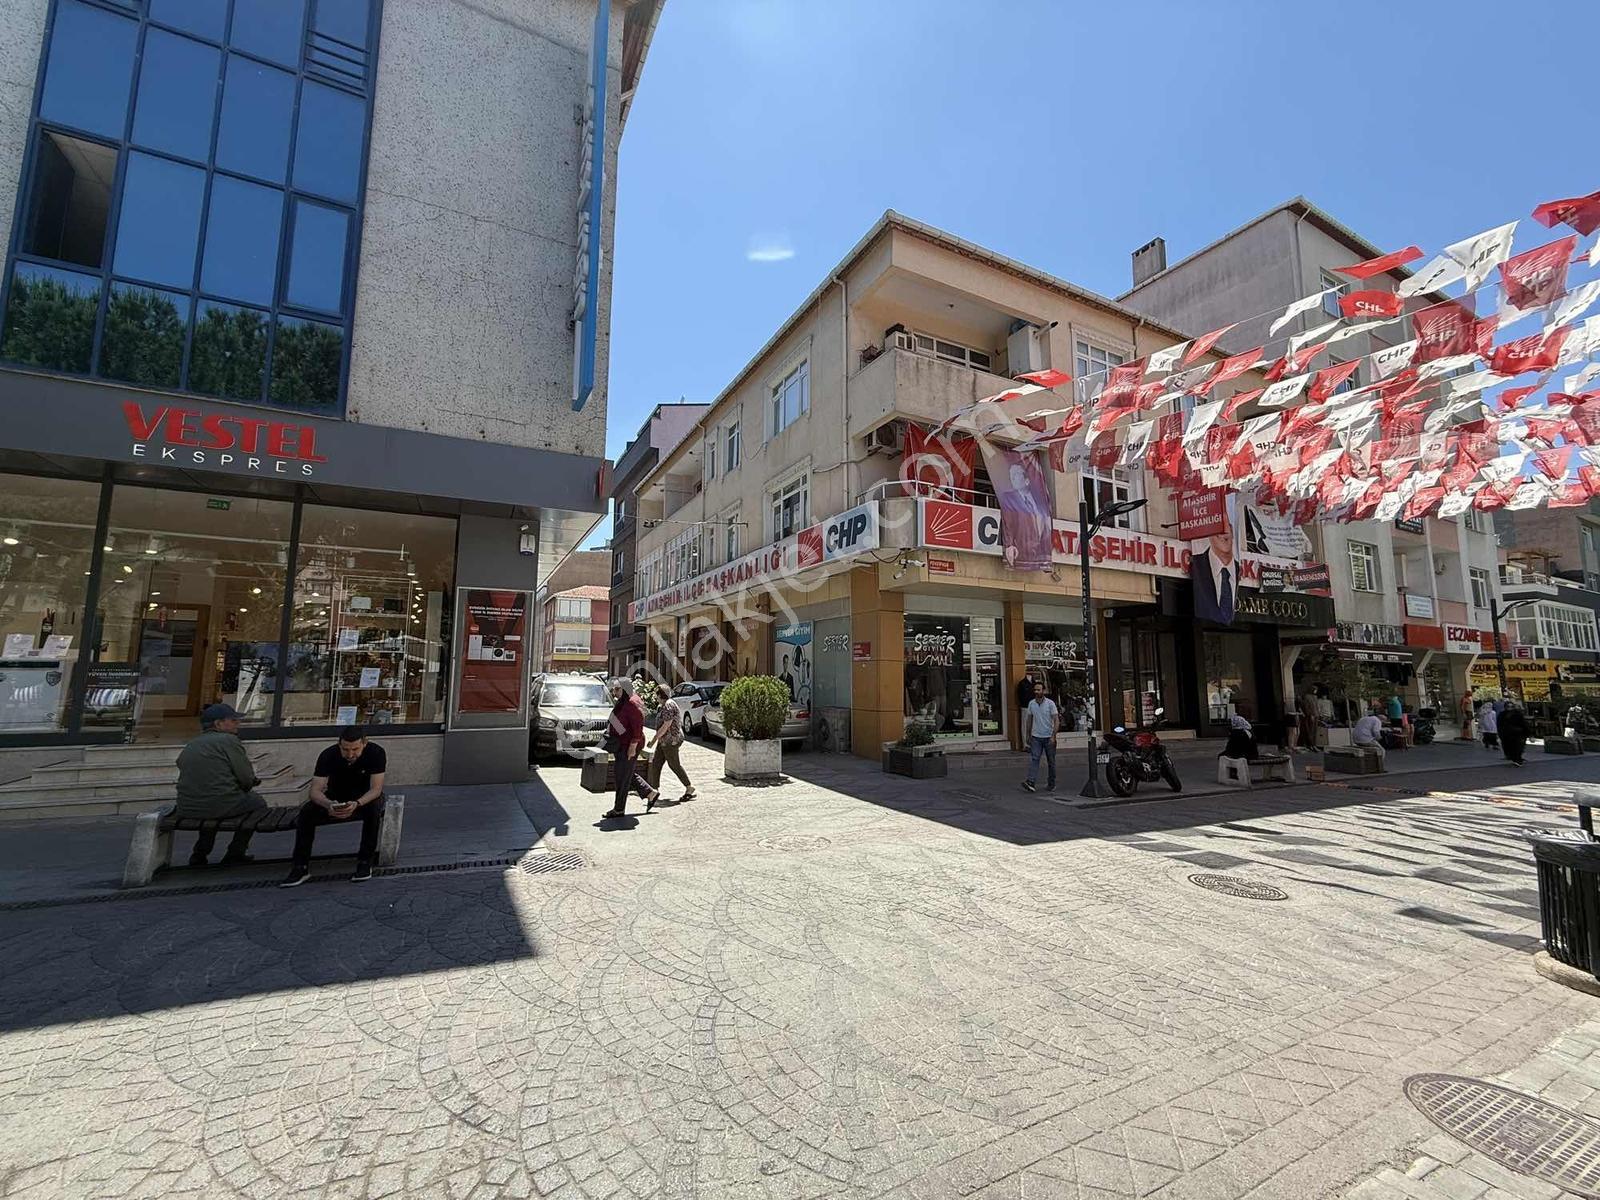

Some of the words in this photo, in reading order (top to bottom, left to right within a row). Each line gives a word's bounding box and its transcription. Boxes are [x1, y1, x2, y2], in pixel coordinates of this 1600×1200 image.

[1421, 329, 1457, 346] CHP
[1378, 346, 1411, 363] CHP
[1508, 347, 1545, 359] CHP
[1271, 382, 1299, 395] CHP
[122, 400, 328, 464] VESTEL
[825, 513, 868, 553] CHP
[1162, 541, 1192, 574] İLÇ
[1273, 599, 1308, 620] COCO
[1447, 626, 1481, 642] ECZANE
[914, 633, 956, 654] SERVER
[1472, 662, 1507, 671] ZURN
